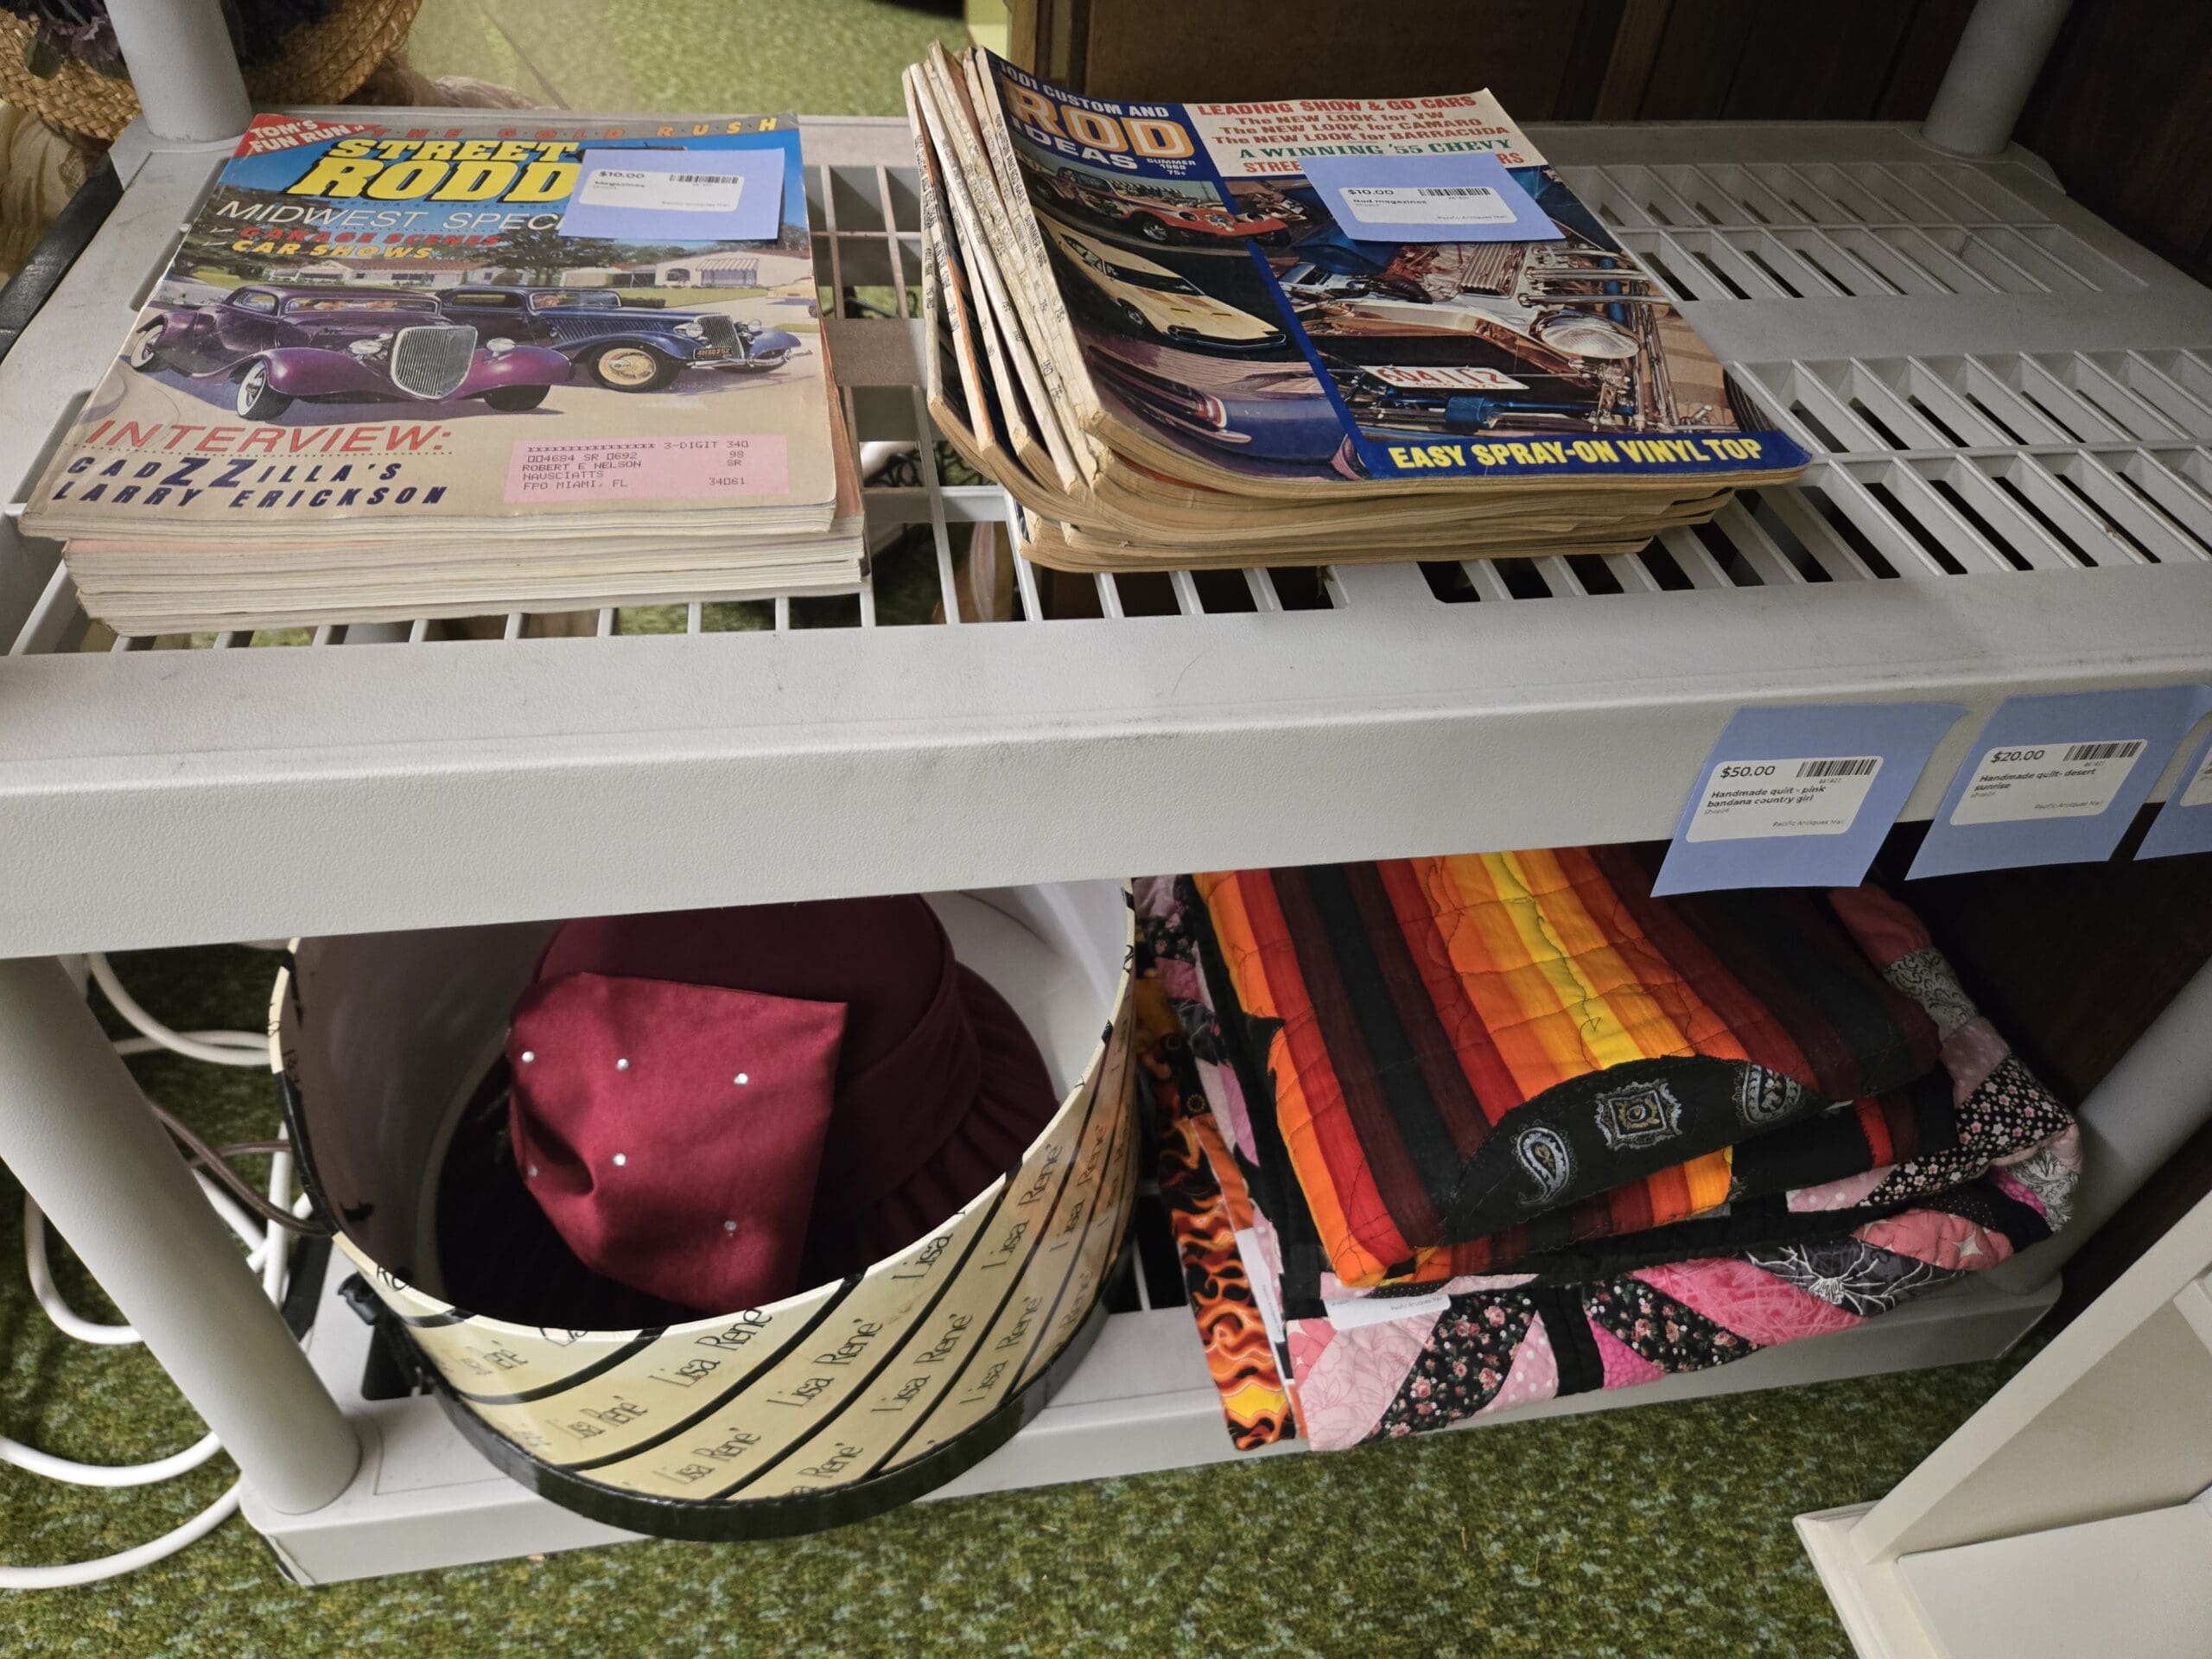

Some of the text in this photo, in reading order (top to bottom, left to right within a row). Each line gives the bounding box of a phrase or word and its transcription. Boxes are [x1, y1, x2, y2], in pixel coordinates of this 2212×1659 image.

[999, 61, 1170, 118] 1001 CUSTOM AND
[1001, 76, 1196, 159] ROD
[1196, 96, 1478, 117] LEADING SHOW & GO CARS
[1234, 111, 1446, 125] The NEW LOOK for VW
[249, 119, 318, 139] TOM'S
[249, 124, 352, 153] FUN RUN
[497, 128, 626, 141] GOLD
[656, 117, 777, 138] RUSH
[1211, 126, 1510, 145] The NEW LOOK for BARRACUDA
[1219, 118, 1484, 135] The NEW LOOK for CAMARO
[327, 137, 582, 162] STREET
[1009, 116, 1139, 169] IDEAS
[1238, 138, 1514, 159] A WINNING '55 CHEVY
[597, 170, 645, 180] $10.00
[214, 200, 429, 229] MIDWEST
[238, 226, 504, 247] GARAGE SCENES
[1025, 213, 1041, 248] SUMMER
[231, 239, 434, 258] CAR SHOWS
[85, 419, 452, 454] INTERVIEW:
[663, 440, 749, 449] 3-DIGIT 340
[583, 453, 600, 461] SR
[606, 451, 639, 461] 0692
[728, 450, 745, 459] 98
[1387, 437, 1764, 469] EASY SPRAY-ON VINYL TOP
[66, 456, 403, 488] CADZZILLA'S
[522, 463, 569, 472] ROBERT
[594, 461, 642, 469] NELSON
[727, 459, 743, 467] SR
[51, 481, 449, 508] LARRY ERICKSON
[523, 482, 549, 491] FPO
[612, 479, 628, 487] FL
[708, 477, 746, 486] 34061
[1991, 749, 2045, 764] $20.00
[1719, 765, 1776, 779] $50.00
[1980, 772, 2034, 782] Handmade
[2064, 768, 2097, 777] desert
[1711, 785, 1827, 798] Handmade quilt pink
[1974, 783, 2012, 791] sunrise
[1707, 794, 1815, 808] bandana country girl
[1048, 1198, 1086, 1253] Lisa
[891, 1232, 954, 1281] Lisa
[980, 1218, 1031, 1271] Lisa
[650, 1357, 721, 1388] Lisa
[958, 1360, 1009, 1404] Lisa
[766, 1376, 836, 1408] Lisa
[870, 1375, 931, 1412] Lisa
[652, 1461, 716, 1485] Lisa
